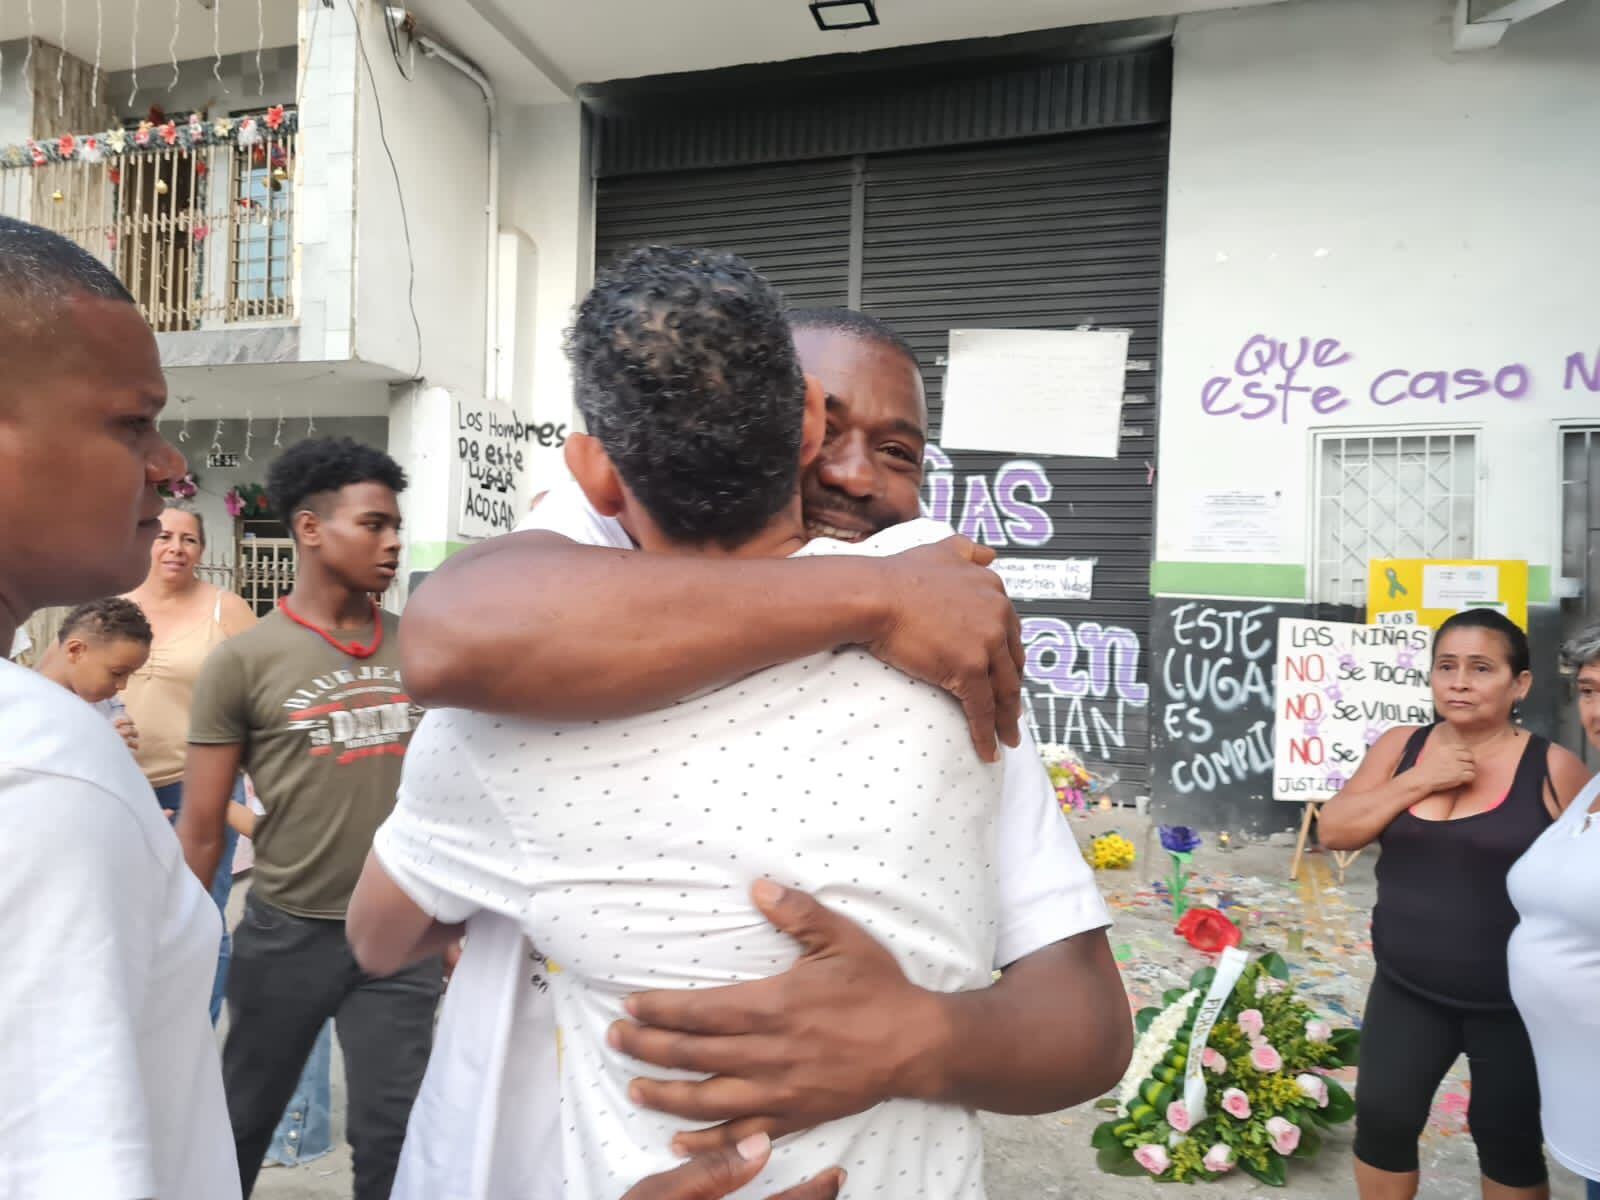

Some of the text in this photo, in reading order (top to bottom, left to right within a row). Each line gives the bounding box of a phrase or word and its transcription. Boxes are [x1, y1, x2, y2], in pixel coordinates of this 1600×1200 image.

[1200, 370, 1351, 424] este
[1369, 363, 1529, 405] caso
[1170, 602, 1275, 660] ESTE
[1292, 625, 1428, 650] LAS NIÑAS
[1163, 648, 1278, 712] LUGA
[1284, 654, 1325, 683] NO
[1369, 661, 1431, 688] TOCAN
[1164, 702, 1214, 743] ES
[1284, 692, 1322, 721] NO
[1361, 701, 1432, 724] VIOLAN
[1289, 736, 1325, 766] NO
